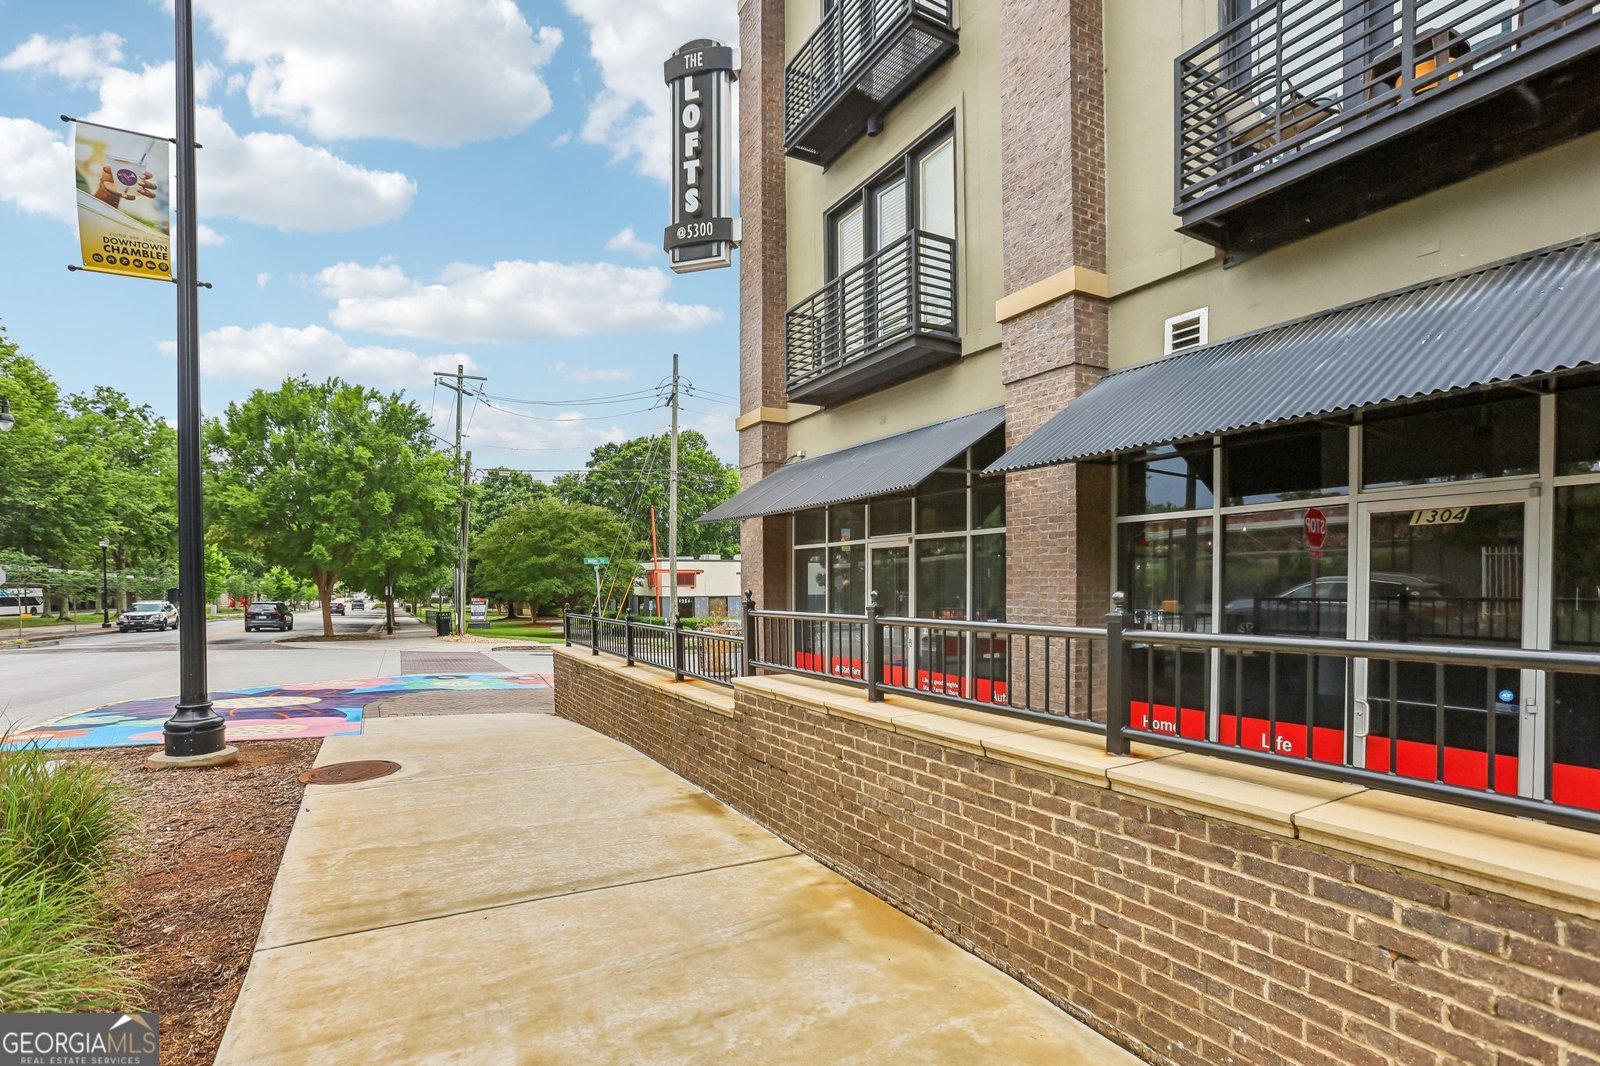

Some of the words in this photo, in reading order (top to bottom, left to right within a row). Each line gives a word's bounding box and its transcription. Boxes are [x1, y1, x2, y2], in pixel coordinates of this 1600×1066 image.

[684, 52, 703, 69] THE
[682, 75, 701, 213] LOFTS
[676, 222, 713, 239] @5300
[103, 236, 168, 252] DOWNTOWN
[103, 244, 169, 261] CHAMBLEE
[1415, 508, 1468, 525] 1304
[993, 690, 1007, 703] Aut
[1261, 732, 1292, 752] Lfe
